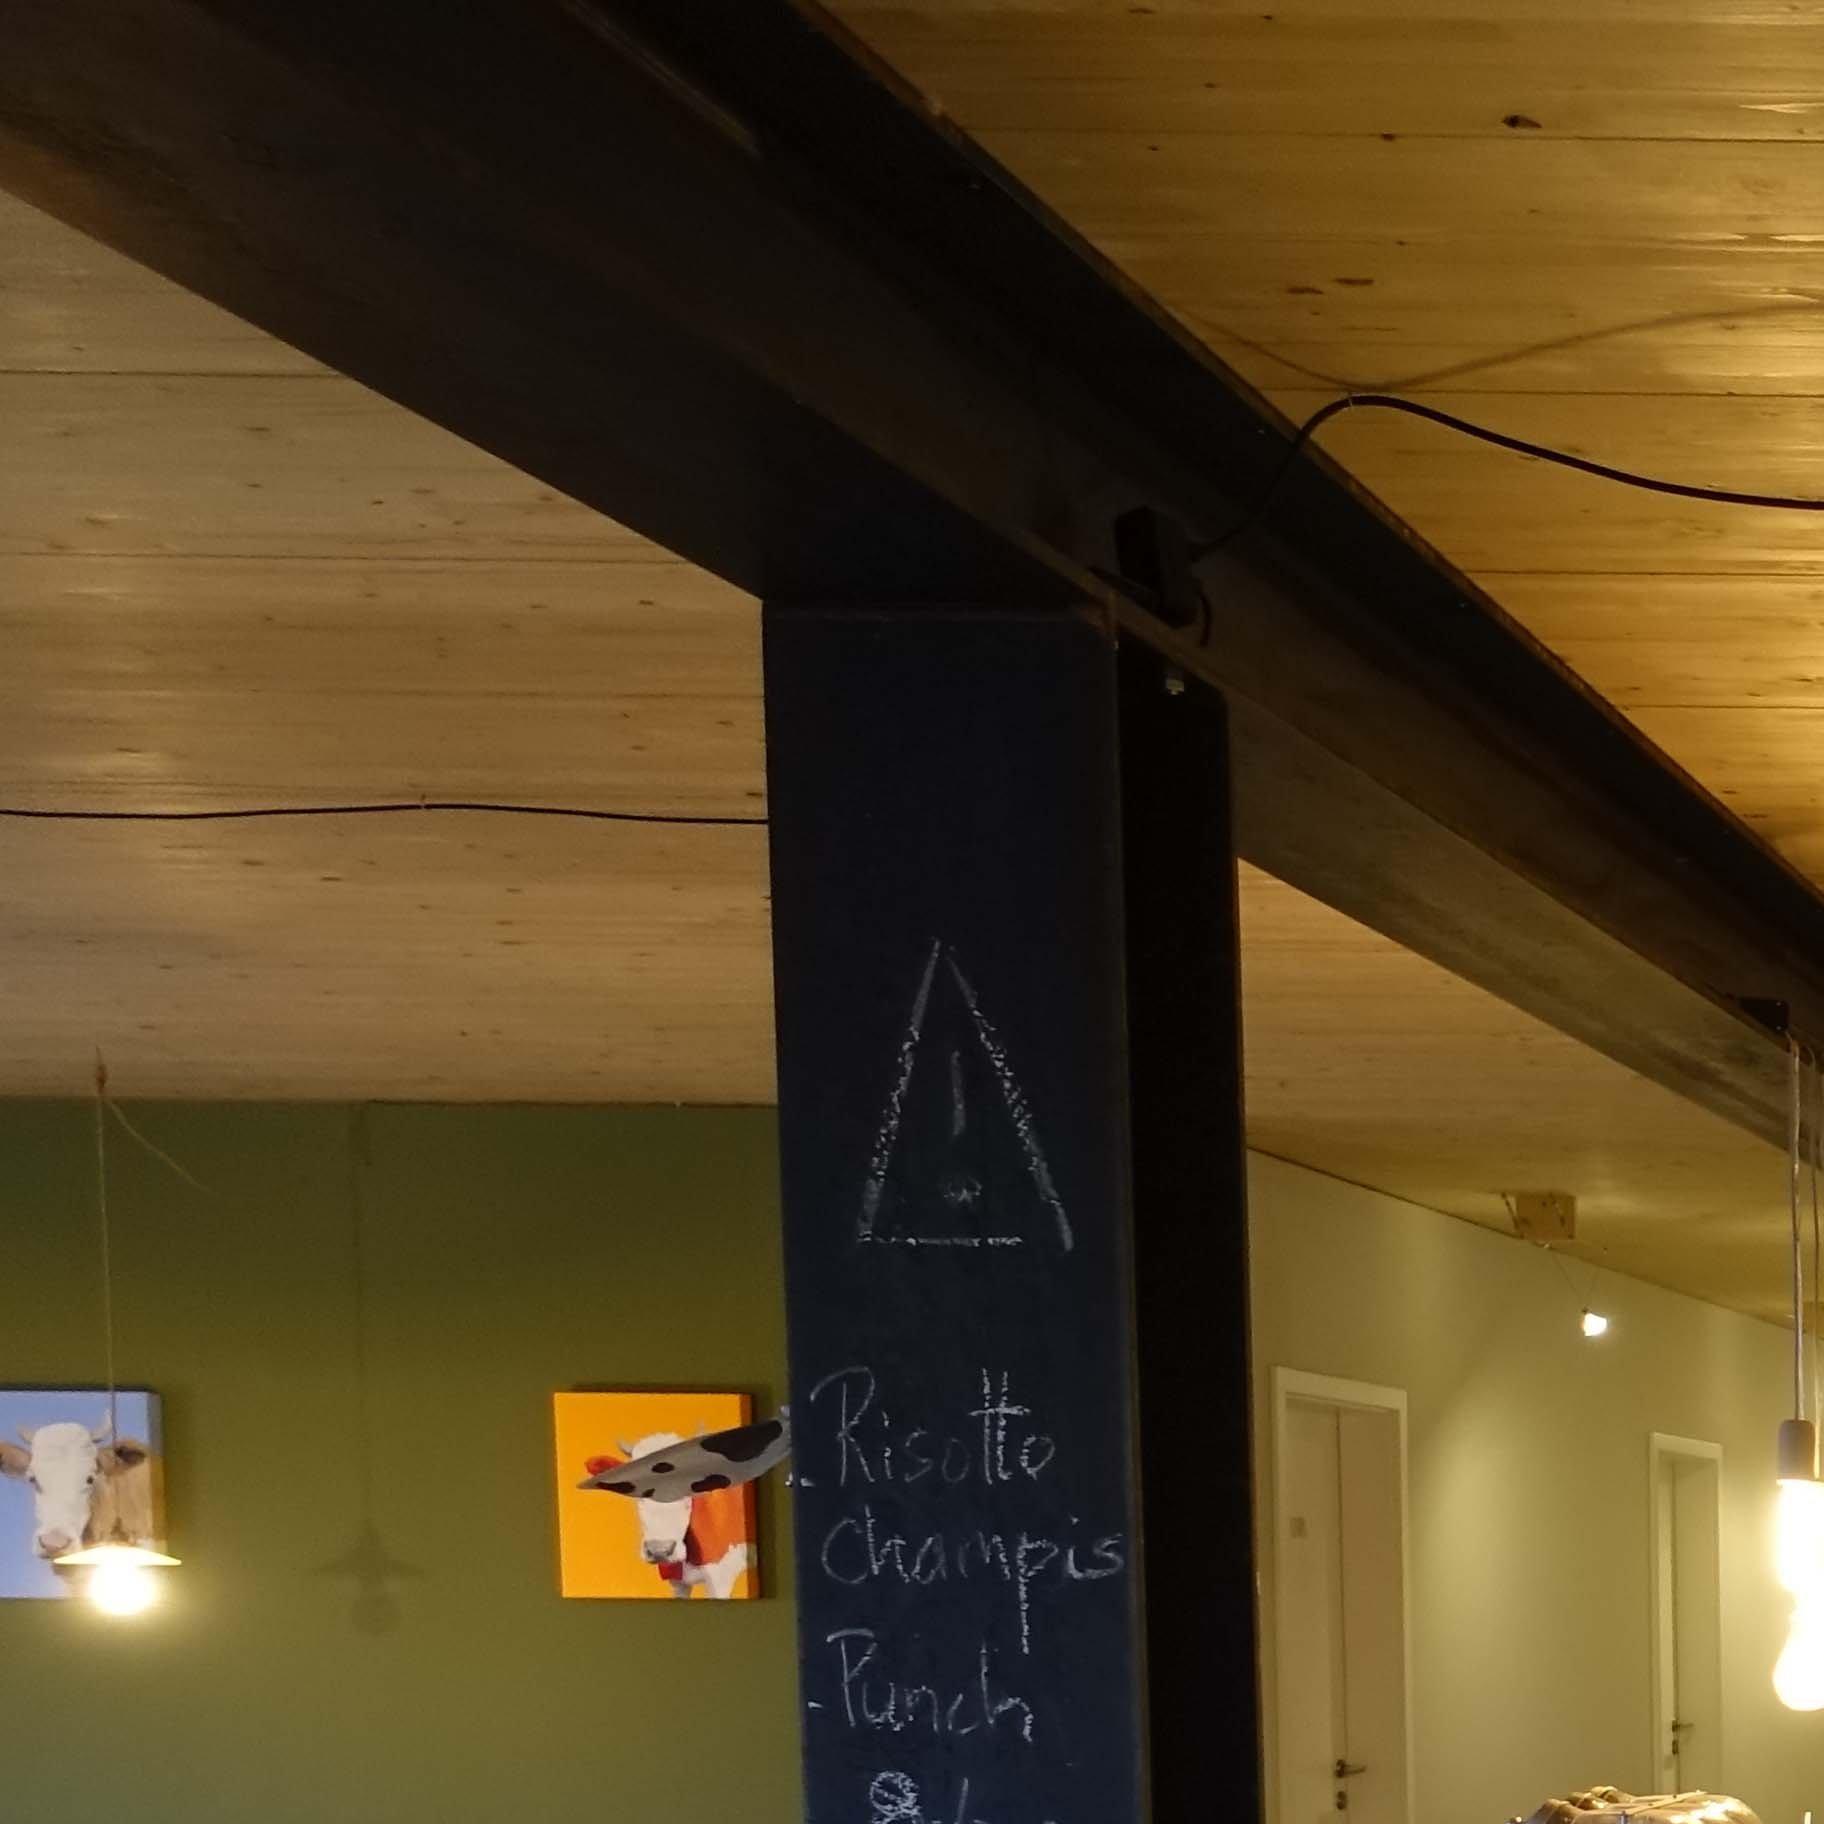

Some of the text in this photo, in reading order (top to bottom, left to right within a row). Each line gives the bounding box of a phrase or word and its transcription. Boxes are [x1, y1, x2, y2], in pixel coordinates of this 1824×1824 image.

[810, 1365, 1056, 1486] Risotto
[820, 1504, 1124, 1654] Champis
[826, 1627, 1033, 1743] Punch
